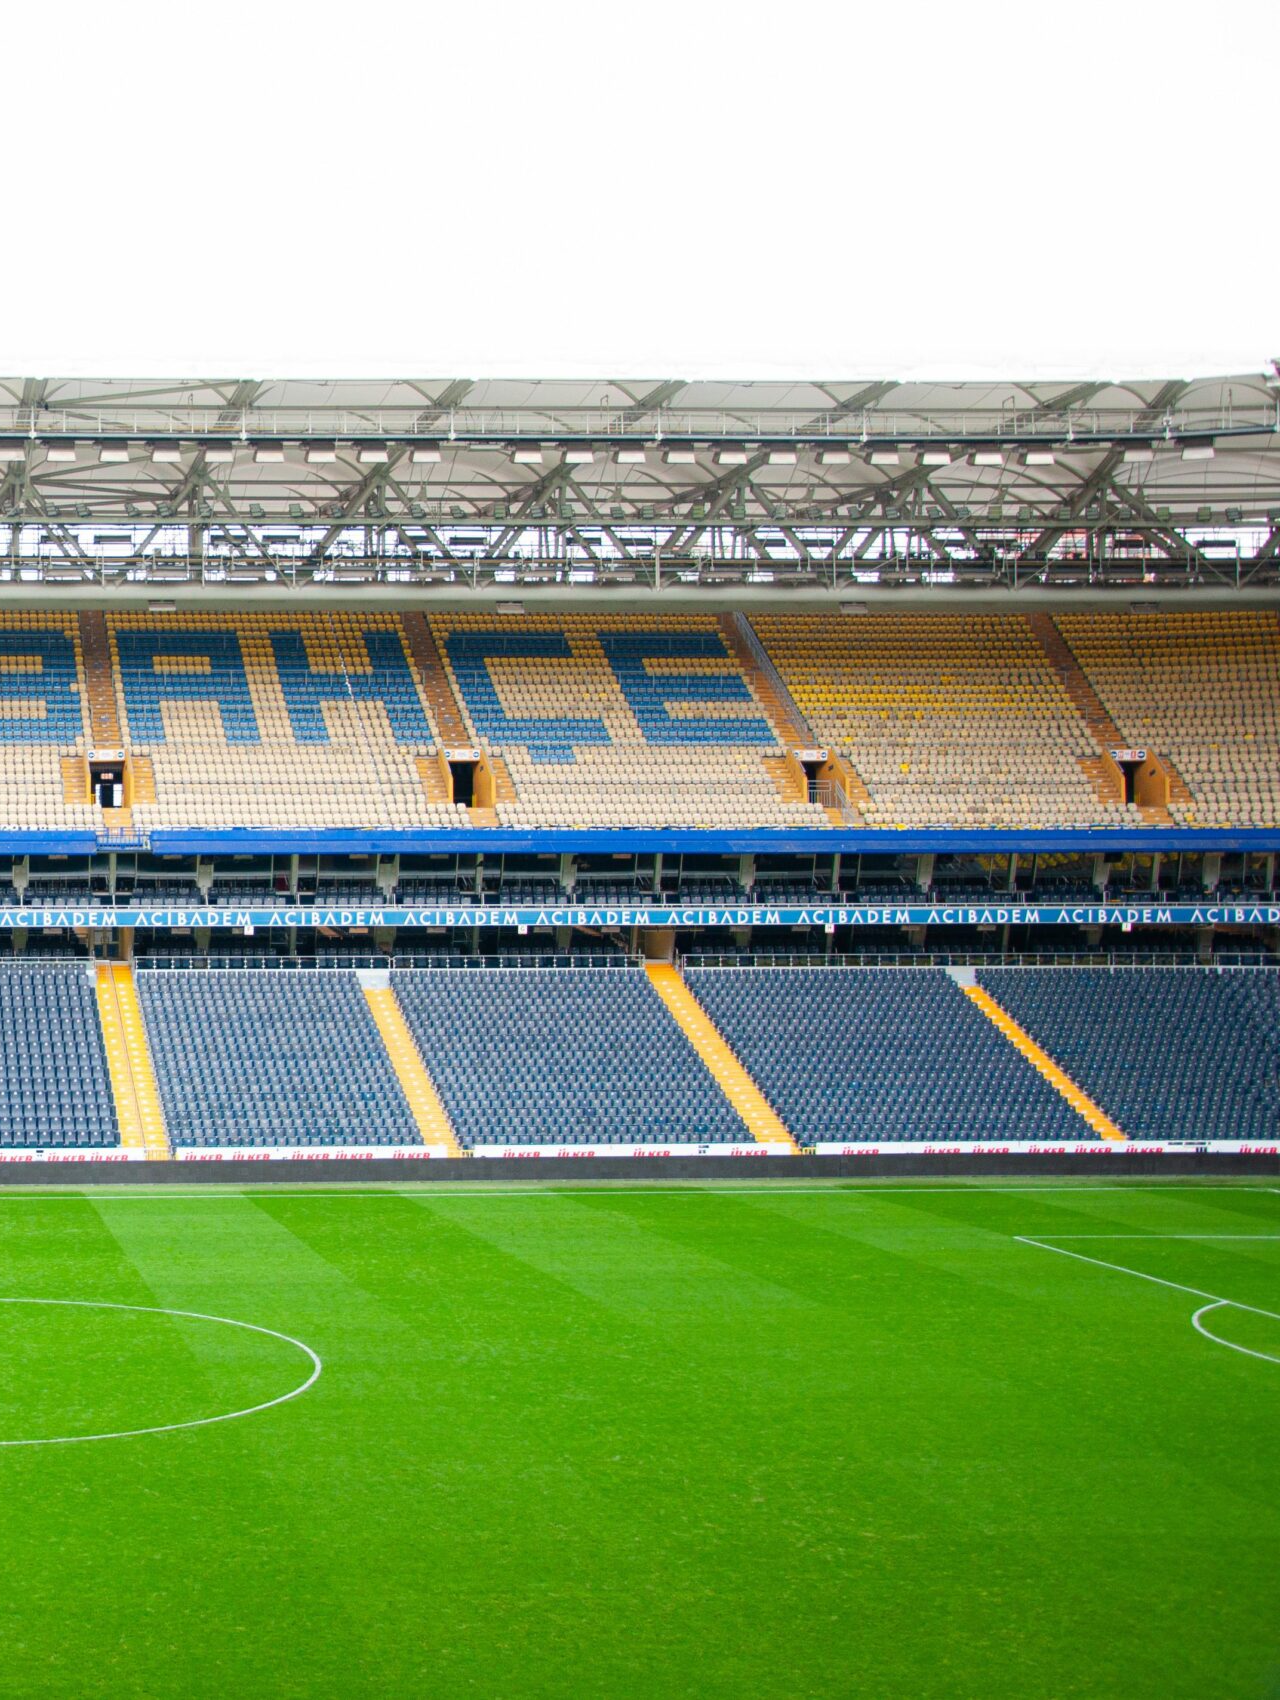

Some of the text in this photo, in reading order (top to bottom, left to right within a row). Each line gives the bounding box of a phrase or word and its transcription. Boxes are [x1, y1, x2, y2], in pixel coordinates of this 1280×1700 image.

[1, 912, 117, 926] ACIBADEM
[136, 912, 251, 925] ACIBADEM
[270, 912, 384, 925] ACIBADEM
[404, 911, 518, 925] ACIBADEM
[537, 911, 649, 924] ACIBADEM
[668, 910, 779, 924] ACIBADEM
[799, 910, 909, 923] ACIBADEM
[928, 909, 1039, 923] ACIBADEM
[1058, 909, 1171, 922] ACIBADEM
